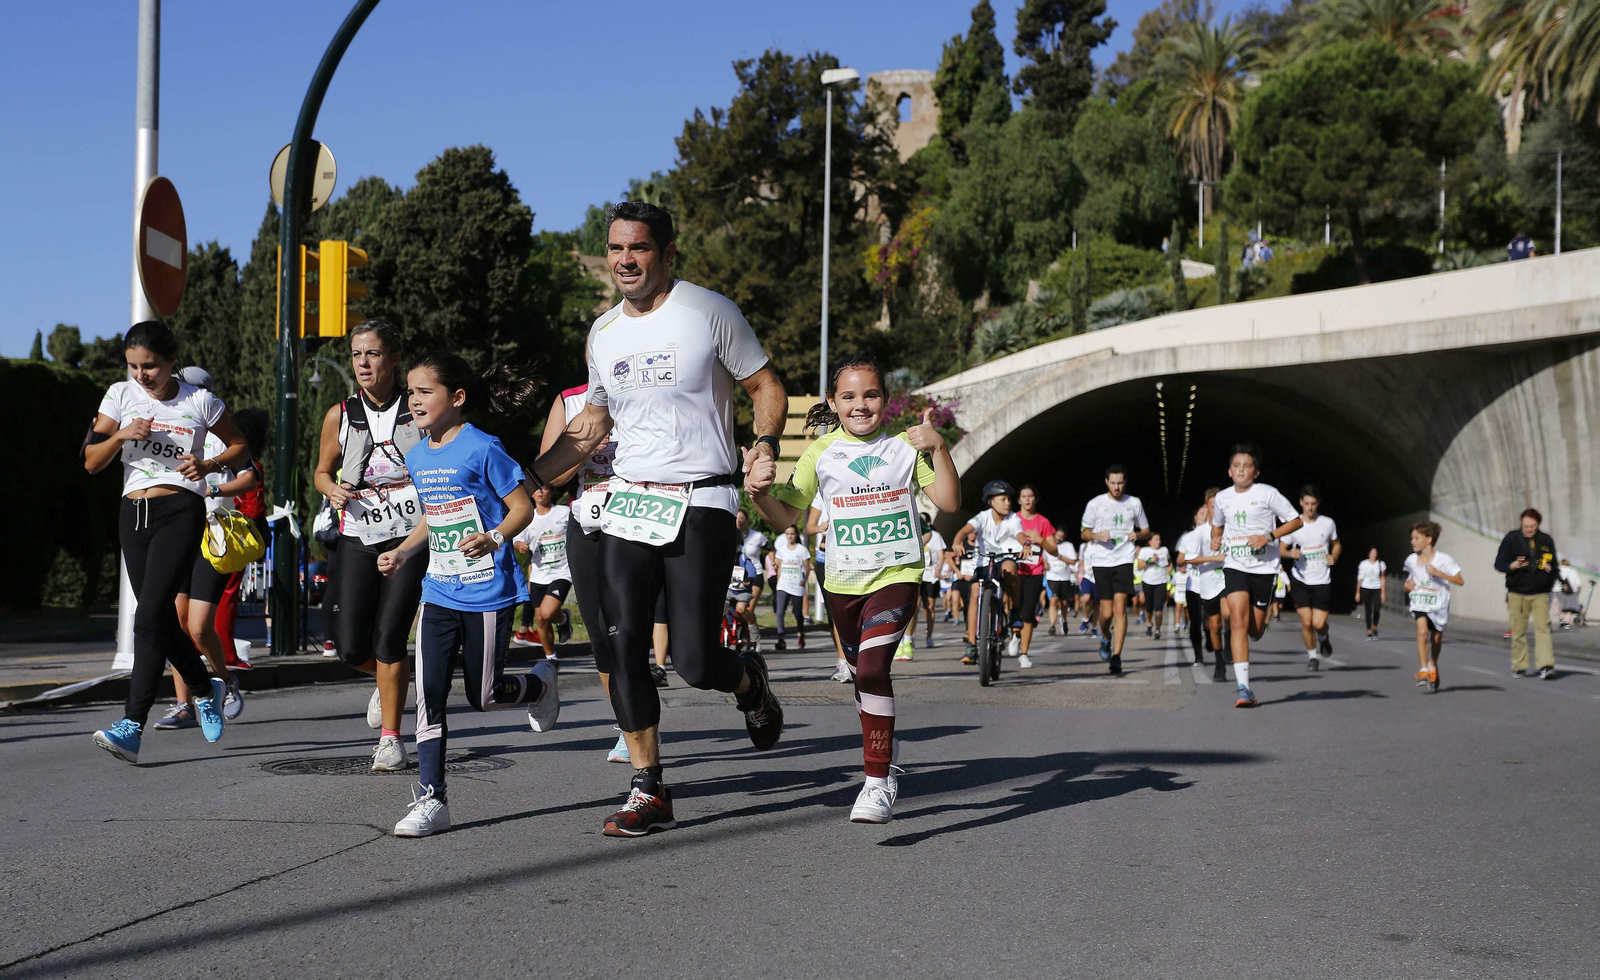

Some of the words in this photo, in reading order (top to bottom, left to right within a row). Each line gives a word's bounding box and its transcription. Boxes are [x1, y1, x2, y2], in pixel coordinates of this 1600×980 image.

[438, 467, 459, 476] Popular
[832, 496, 845, 508] 41
[845, 492, 880, 503] CARRERA
[881, 487, 909, 498] URBANA
[877, 496, 900, 504] MALAGA
[442, 498, 474, 510] URBANA
[361, 500, 416, 525] 18118
[609, 497, 677, 525] 20524
[837, 517, 909, 545] 20525
[870, 730, 889, 740] MA
[871, 740, 889, 750] HA
